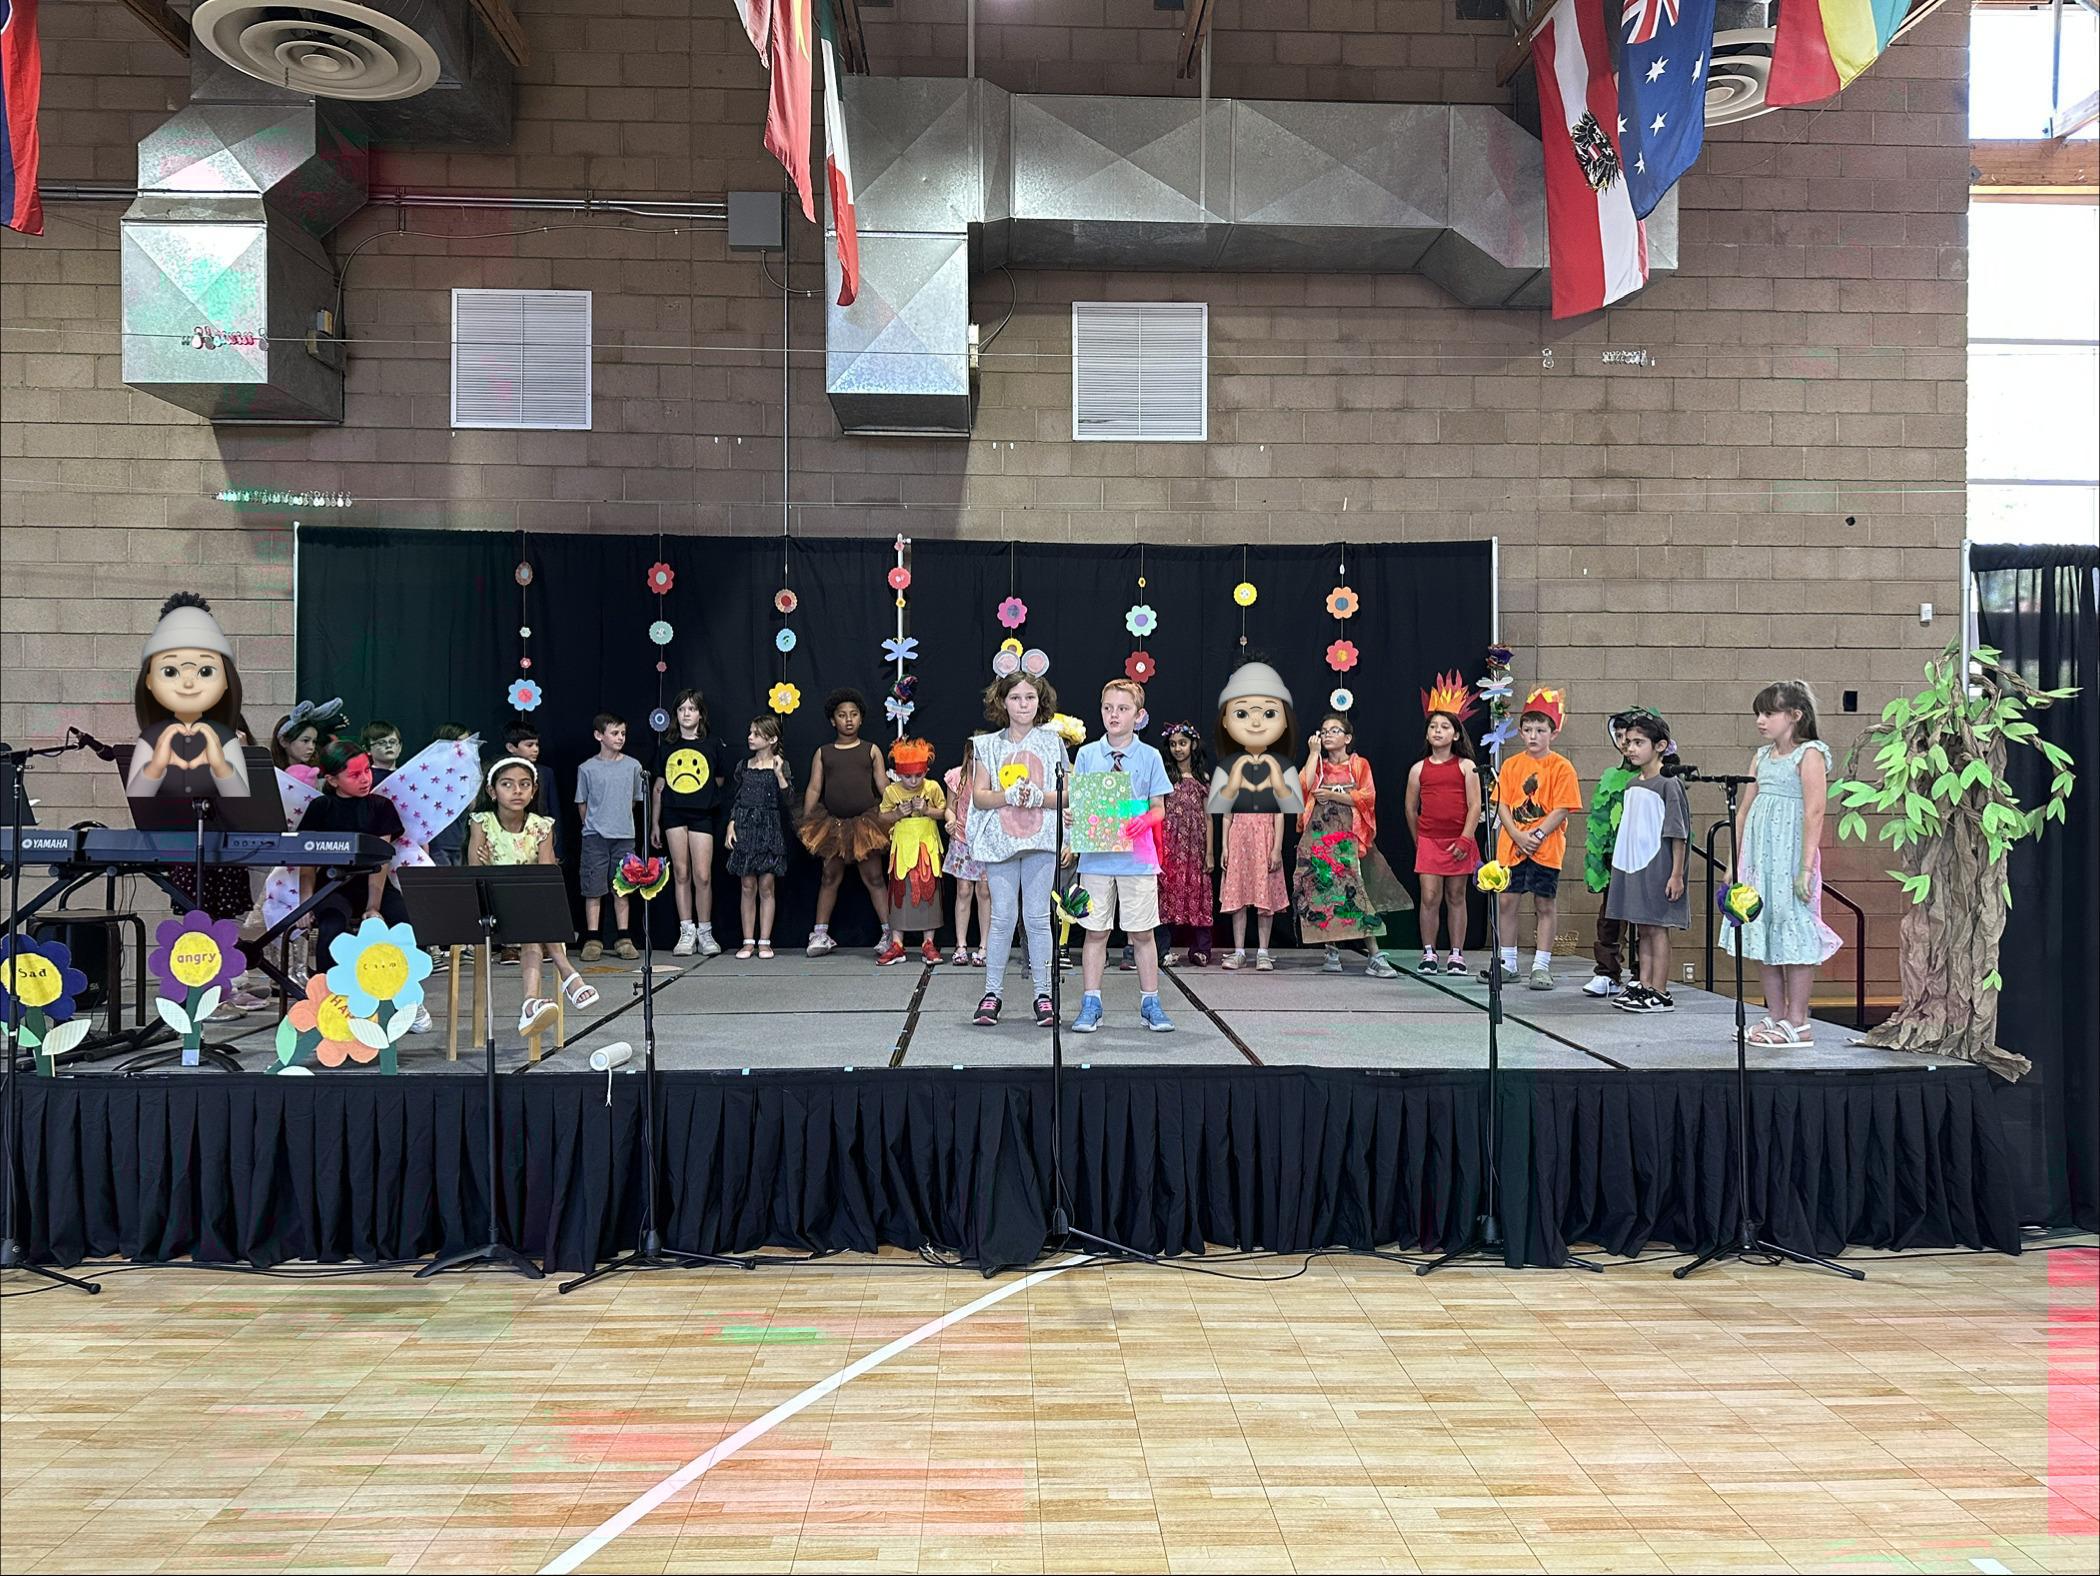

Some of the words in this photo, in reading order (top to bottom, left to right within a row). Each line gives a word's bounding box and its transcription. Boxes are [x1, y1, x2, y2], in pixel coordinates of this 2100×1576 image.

[33, 839, 68, 849] YAMAHA
[315, 841, 350, 851] YAMAHA
[177, 953, 216, 965] angry
[18, 968, 47, 978] Sad
